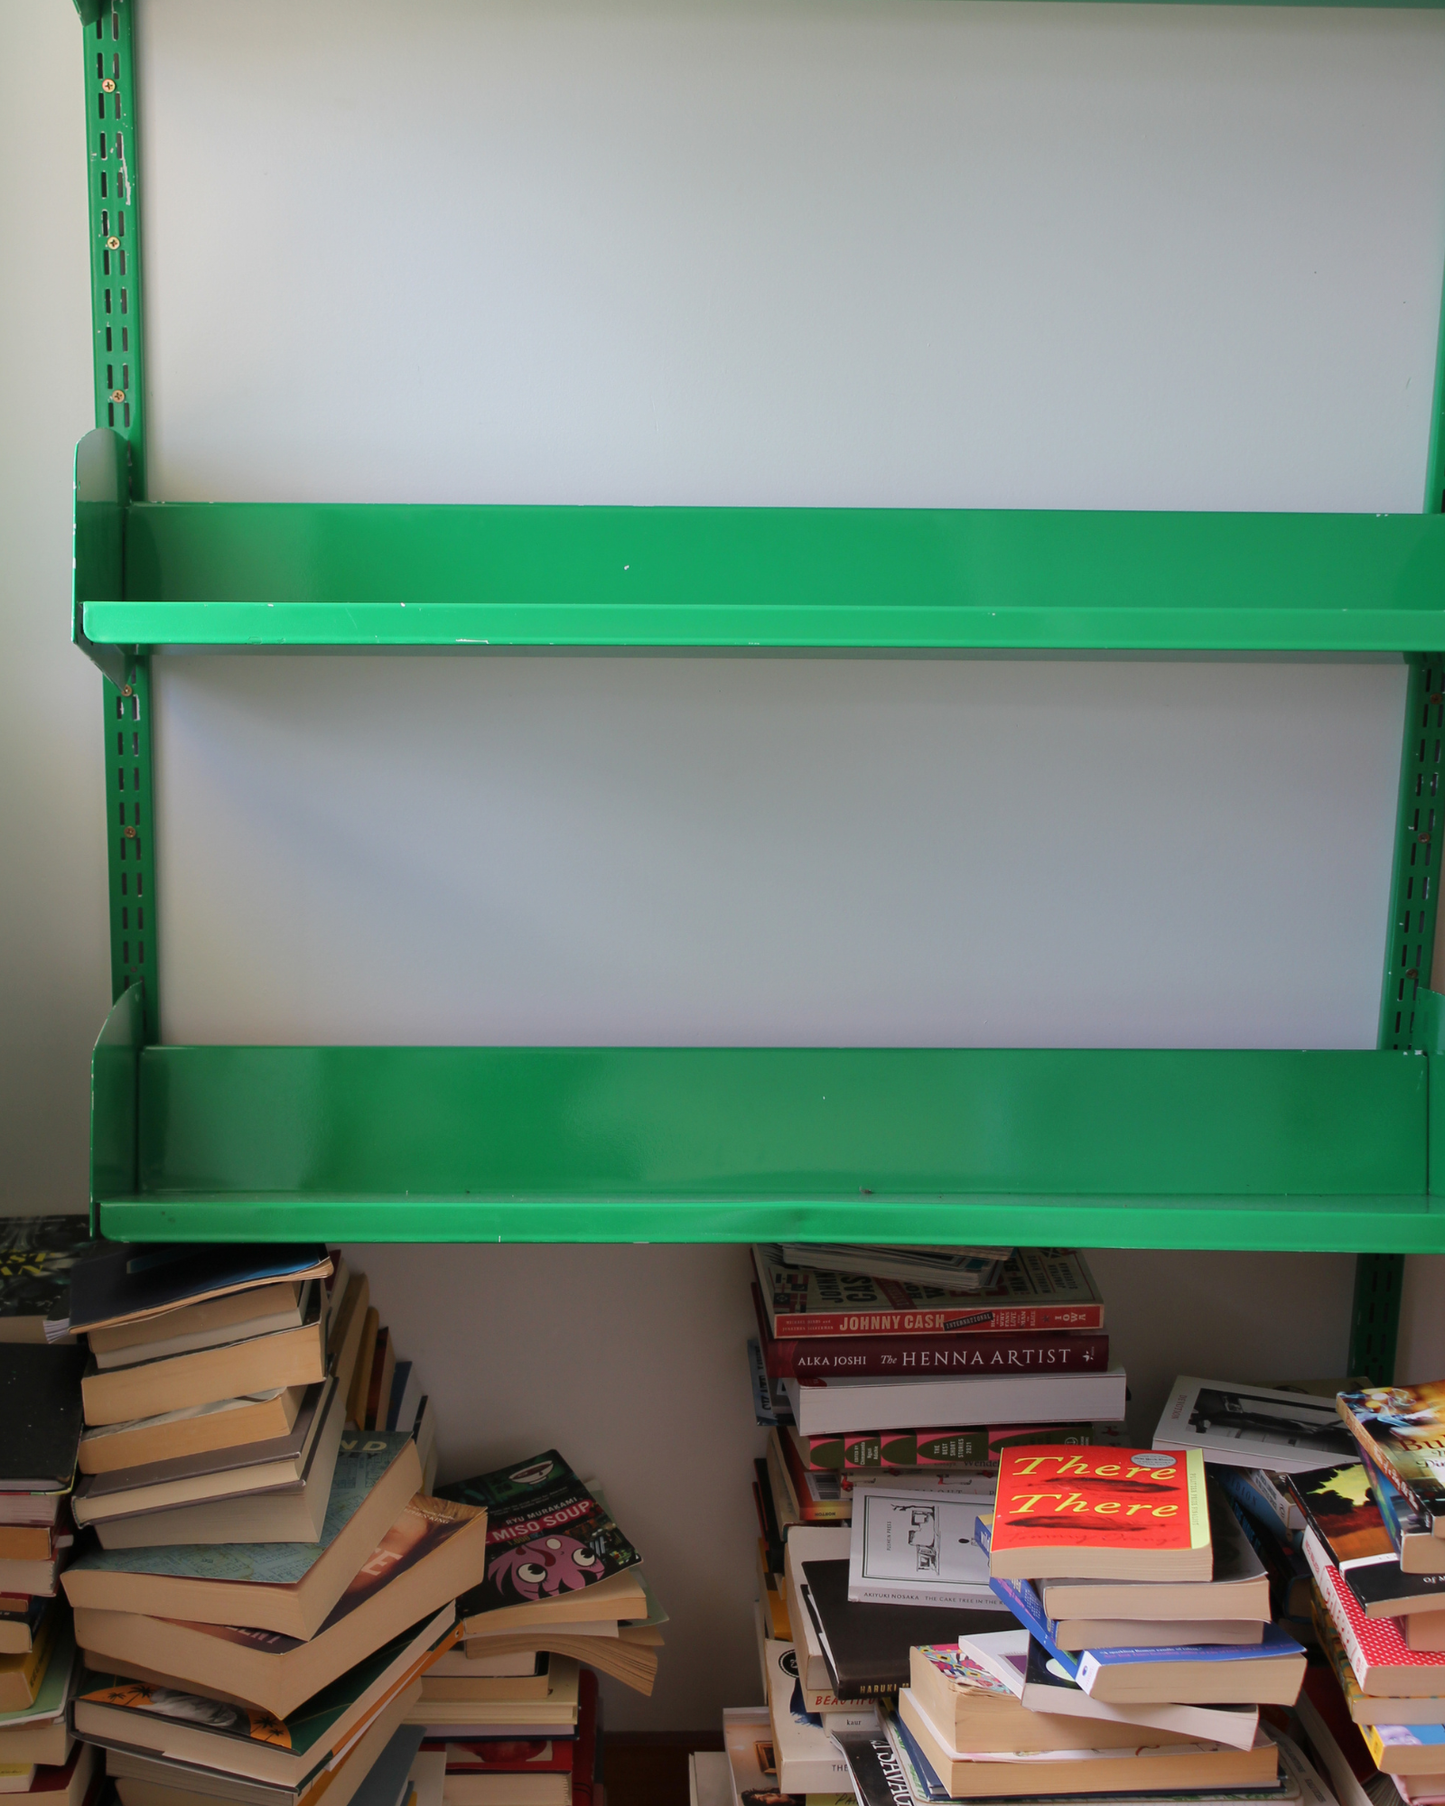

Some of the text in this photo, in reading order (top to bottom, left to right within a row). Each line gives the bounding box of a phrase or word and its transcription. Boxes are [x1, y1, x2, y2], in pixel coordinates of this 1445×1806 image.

[840, 1274, 878, 1303] CAS
[839, 1314, 945, 1331] JOHNNY CASH
[945, 1313, 991, 1330] INTERNATIONAL
[797, 1355, 867, 1367] ALKA JOSHI
[880, 1348, 1072, 1367] The HENNA ARTIST
[1012, 1455, 1177, 1481] There
[505, 1515, 525, 1526] RYU
[526, 1496, 578, 1520] MURAKAMI
[1009, 1492, 1179, 1518] There
[492, 1521, 541, 1542] MISO
[543, 1500, 590, 1527] SOUP
[860, 1683, 898, 1694] HARUKI
[832, 1764, 849, 1772] THE
